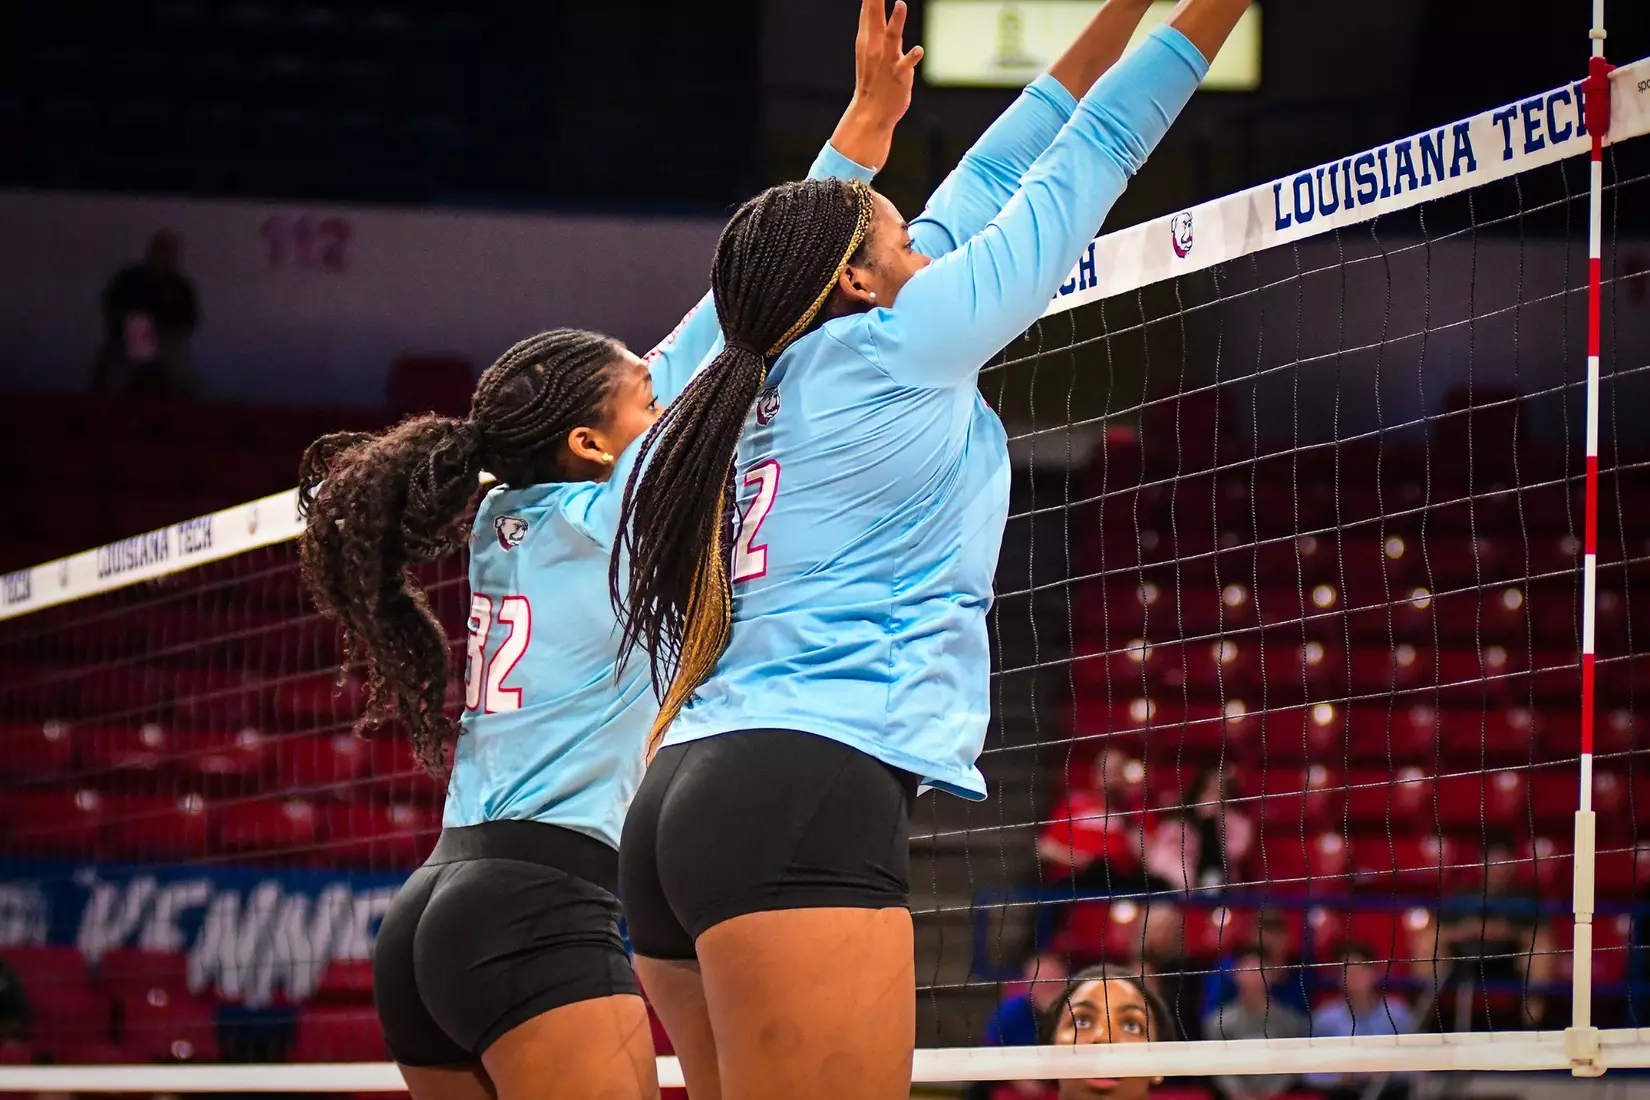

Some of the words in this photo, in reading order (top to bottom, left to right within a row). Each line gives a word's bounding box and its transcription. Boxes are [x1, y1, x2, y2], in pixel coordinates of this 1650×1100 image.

[1273, 121, 1477, 231] LOUISIANA
[97, 528, 169, 578] LOUISIANA
[176, 515, 212, 557] TECH
[465, 592, 532, 714] 32
